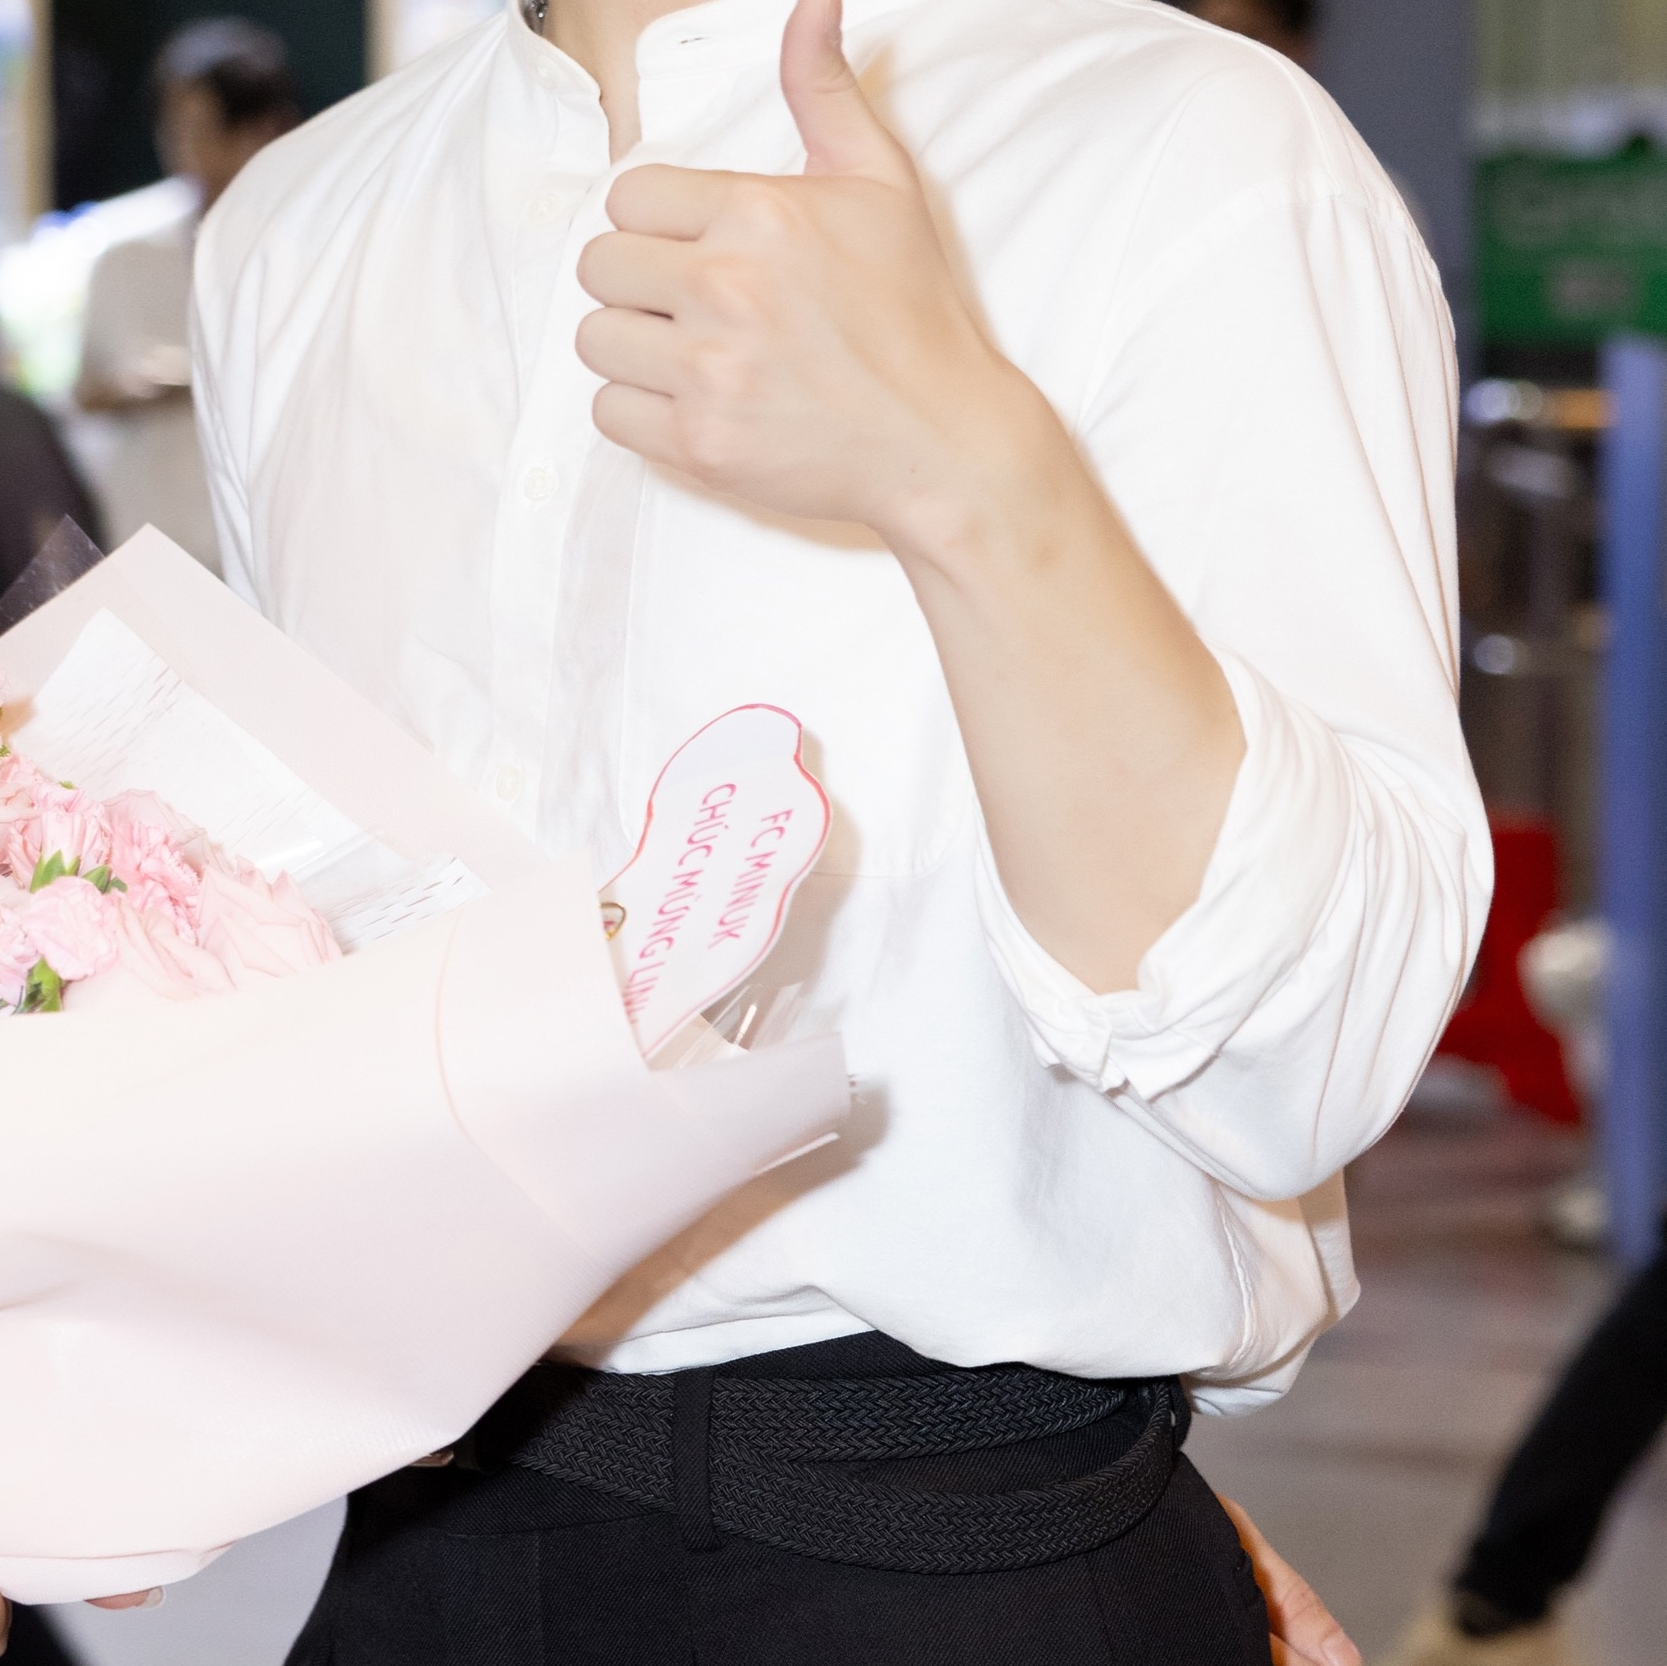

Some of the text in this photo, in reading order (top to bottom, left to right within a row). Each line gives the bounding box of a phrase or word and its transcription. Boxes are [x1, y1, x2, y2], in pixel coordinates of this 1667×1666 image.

[678, 783, 737, 867] CHÚC
[708, 808, 794, 950] FC MINUK
